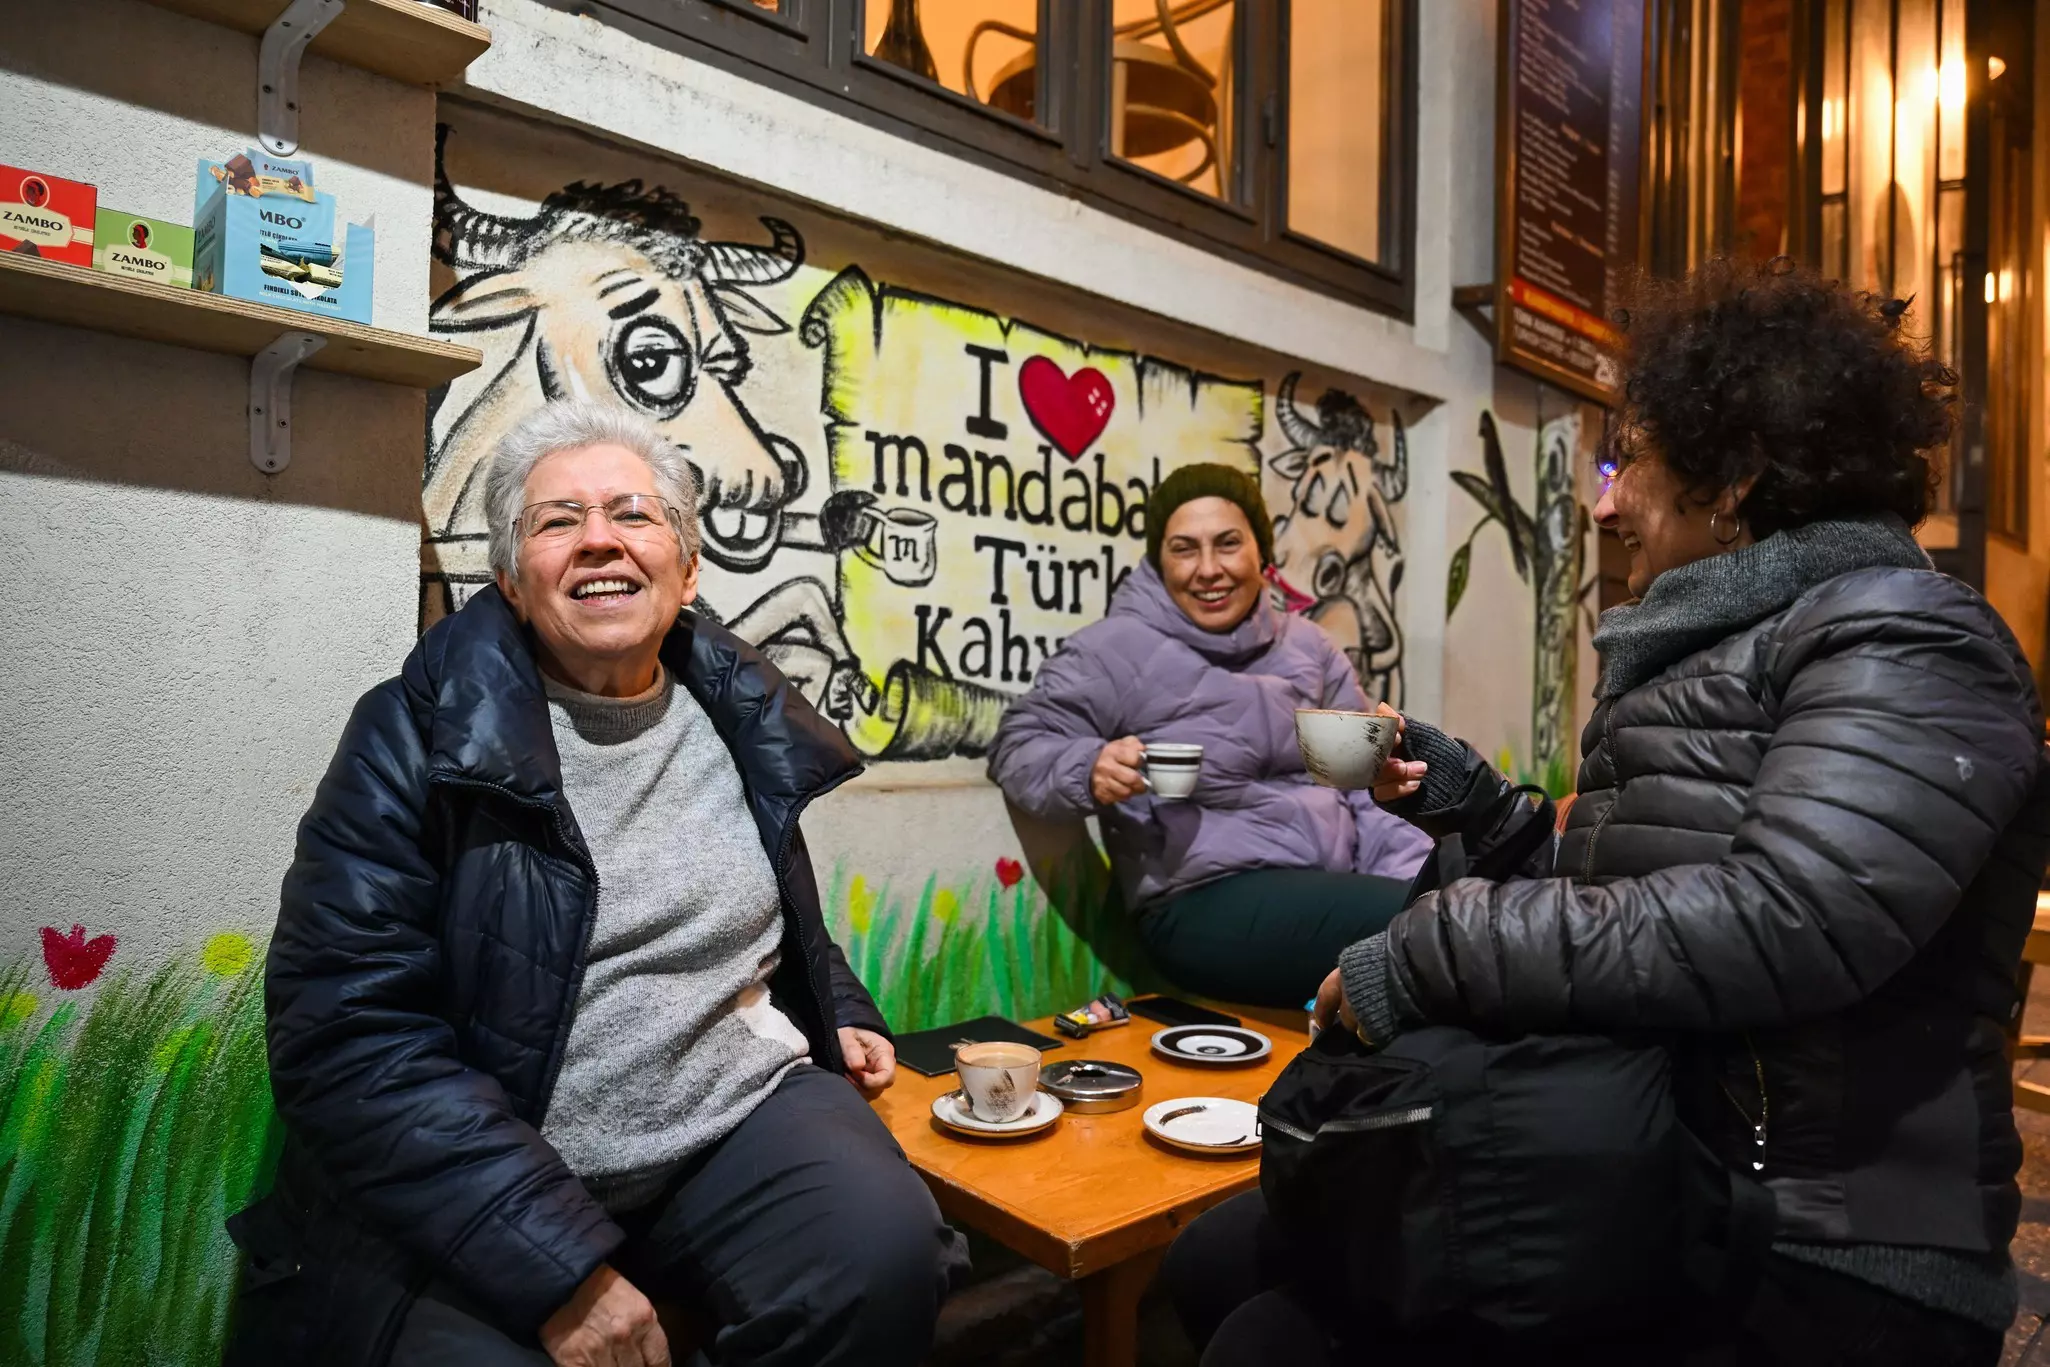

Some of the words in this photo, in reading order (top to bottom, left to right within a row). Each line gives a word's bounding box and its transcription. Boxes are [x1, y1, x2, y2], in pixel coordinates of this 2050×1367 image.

[3, 210, 63, 231] ZAMBO
[111, 252, 165, 271] ZAMBO
[263, 284, 290, 295] FINDIKLI
[965, 343, 1009, 440] I
[888, 534, 920, 563] m
